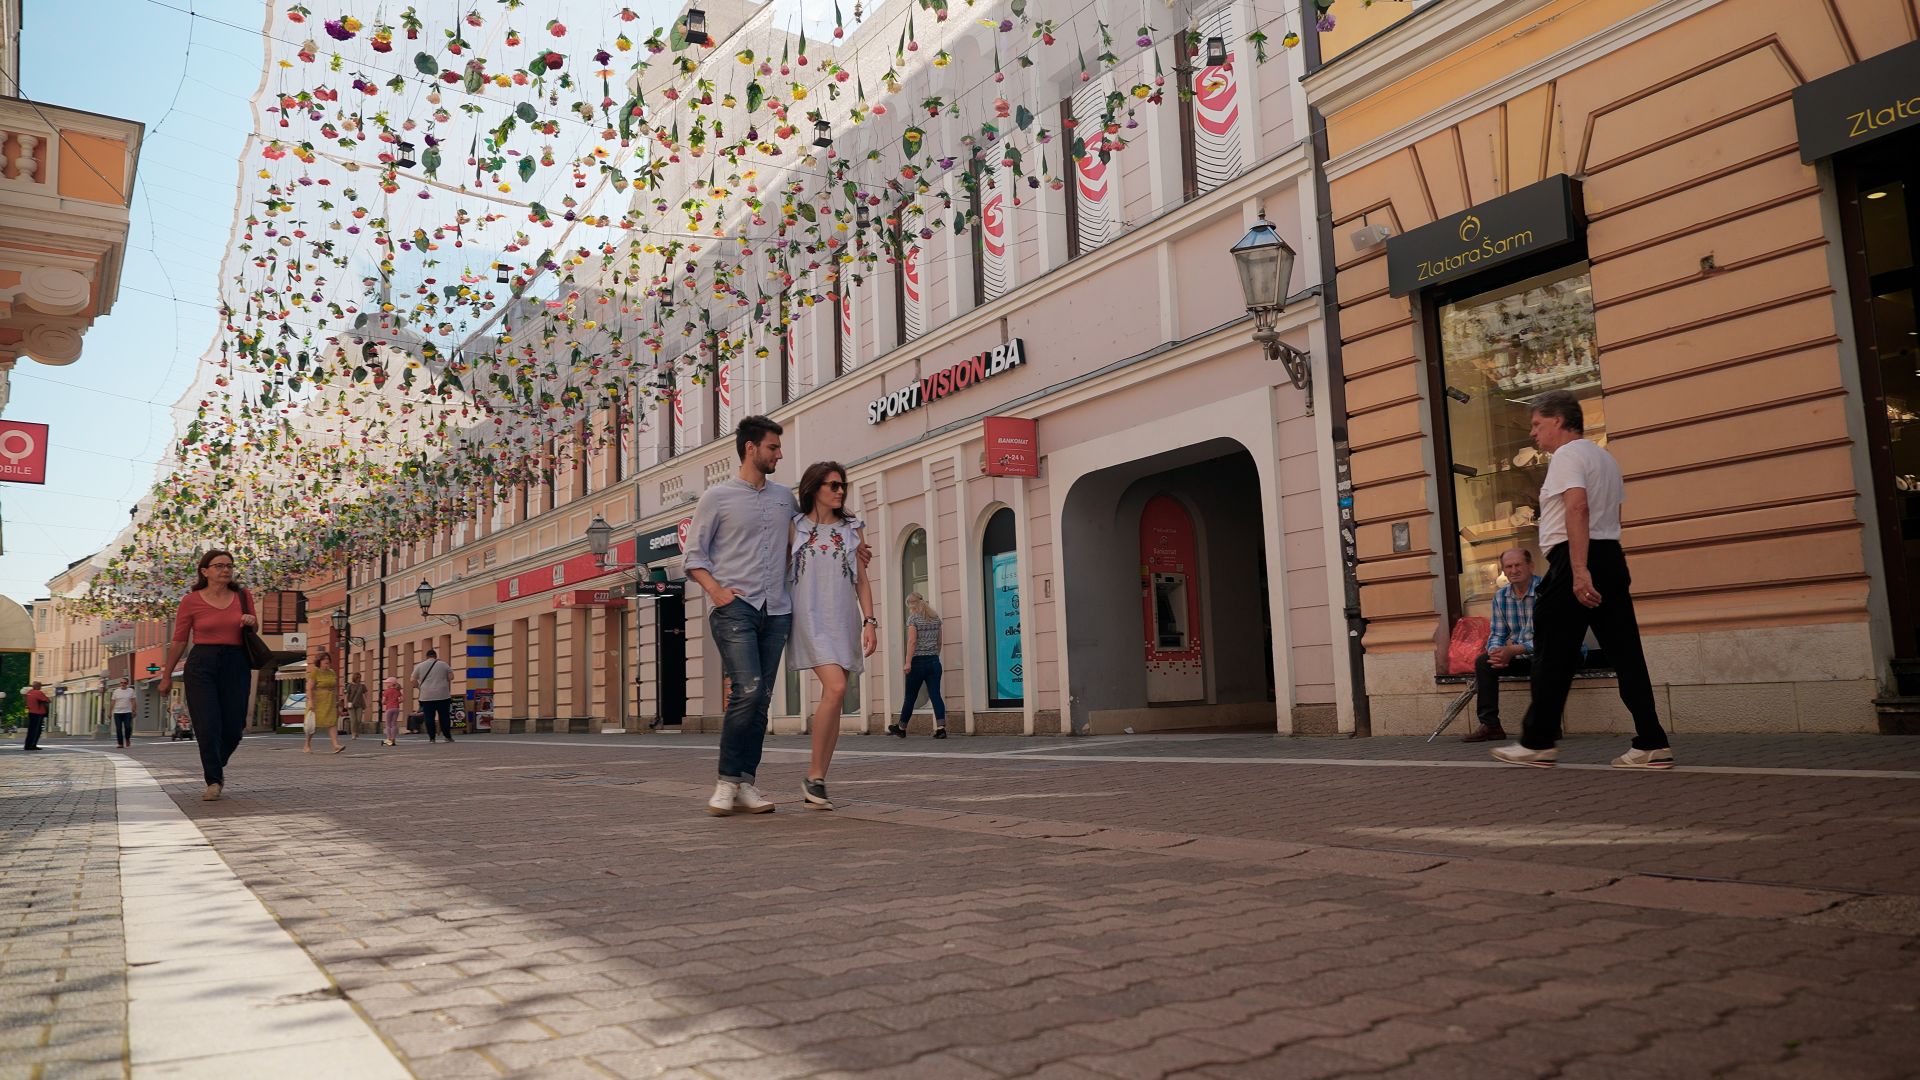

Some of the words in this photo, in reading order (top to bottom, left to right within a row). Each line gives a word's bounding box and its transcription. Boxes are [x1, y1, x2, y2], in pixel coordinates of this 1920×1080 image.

[1416, 248, 1480, 281] Zlatara
[1482, 230, 1533, 259] Šarm
[867, 338, 1024, 425] SPORTVISION.BA
[997, 436, 1029, 445] BANKOMAT
[649, 532, 677, 550] SPORT
